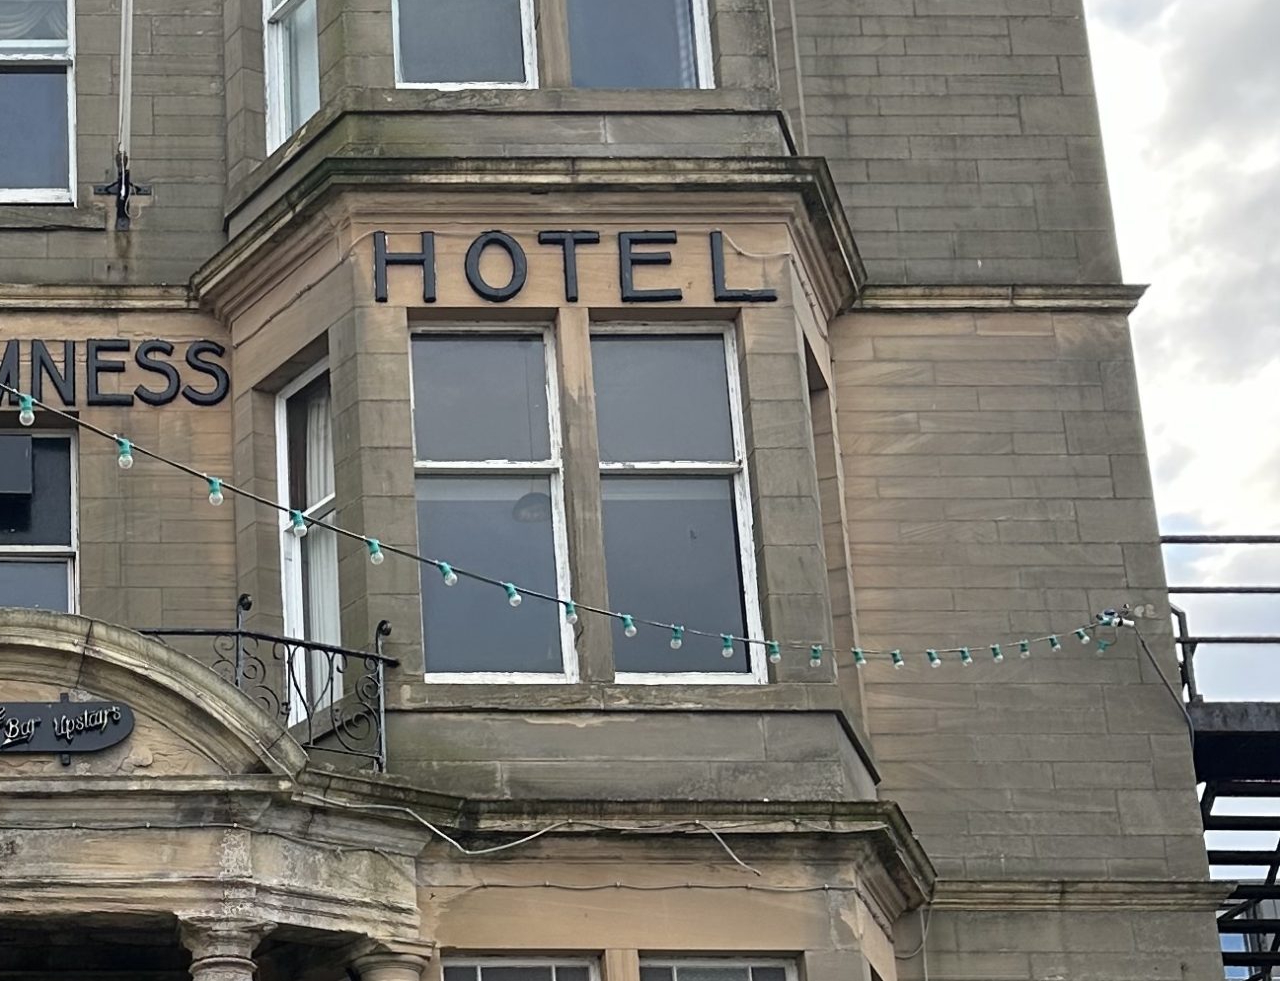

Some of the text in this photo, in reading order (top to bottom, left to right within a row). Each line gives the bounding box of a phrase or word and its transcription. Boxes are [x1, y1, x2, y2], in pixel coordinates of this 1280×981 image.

[373, 229, 778, 304] HOTEL
[3, 718, 41, 747] Bar
[53, 706, 121, 739] Upstairs
